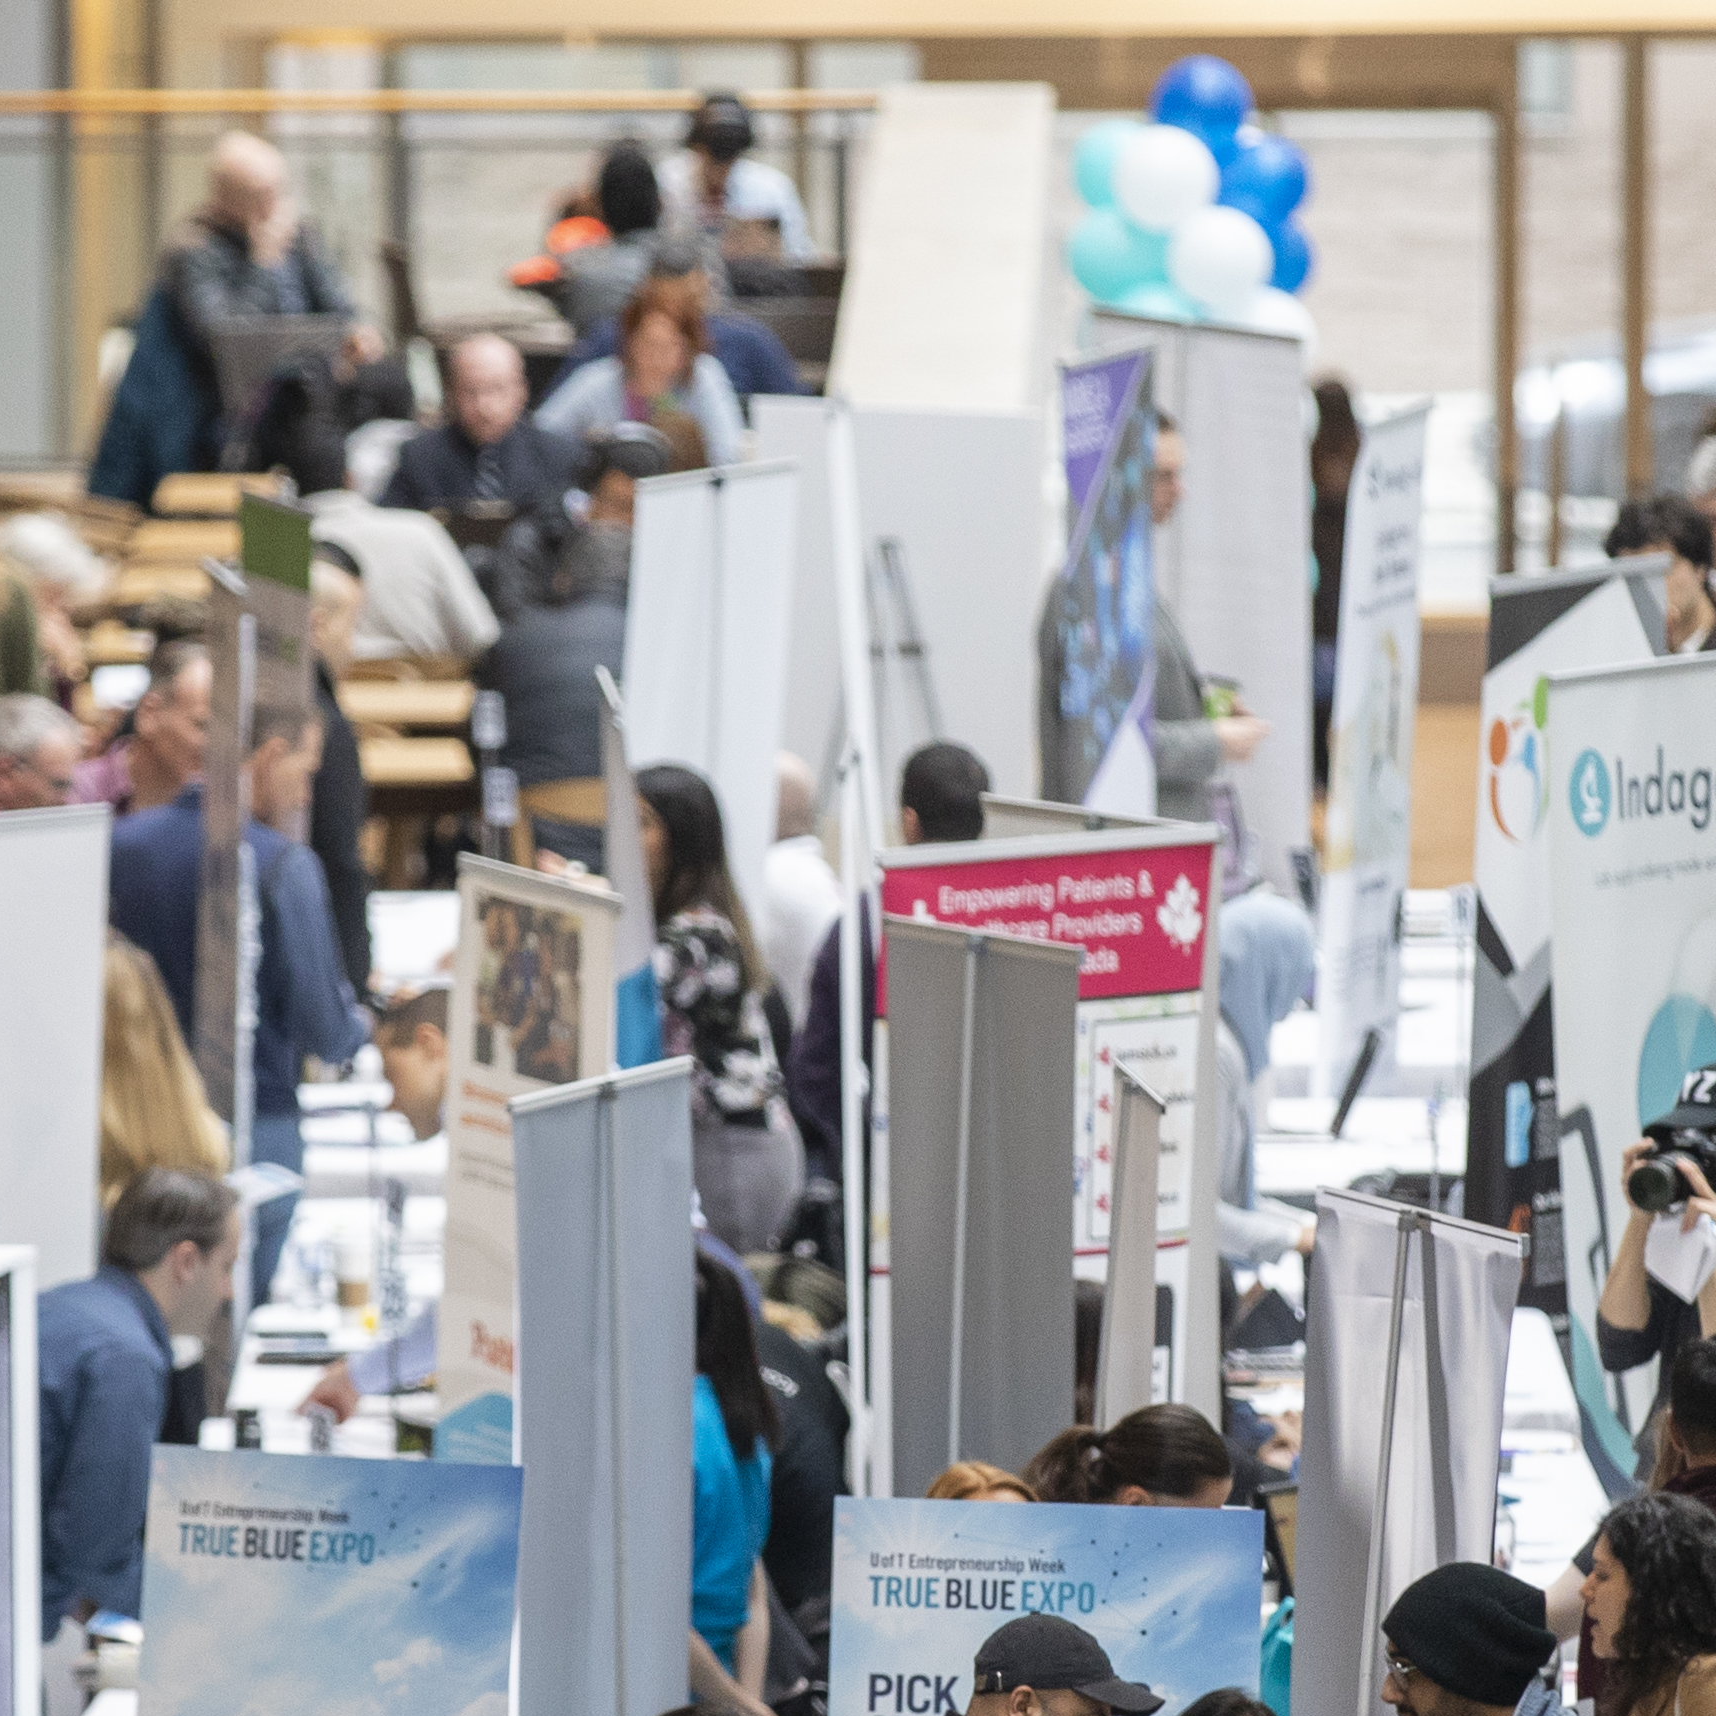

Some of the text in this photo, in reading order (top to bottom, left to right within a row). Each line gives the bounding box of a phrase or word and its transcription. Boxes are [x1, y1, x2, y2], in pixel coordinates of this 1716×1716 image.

[937, 869, 1155, 915] Empowering Patients &
[1051, 909, 1144, 941] Providers
[909, 1553, 1025, 1575] Entrepreneurship
[1028, 1556, 1066, 1574] Week
[868, 1673, 960, 1714] PICK
